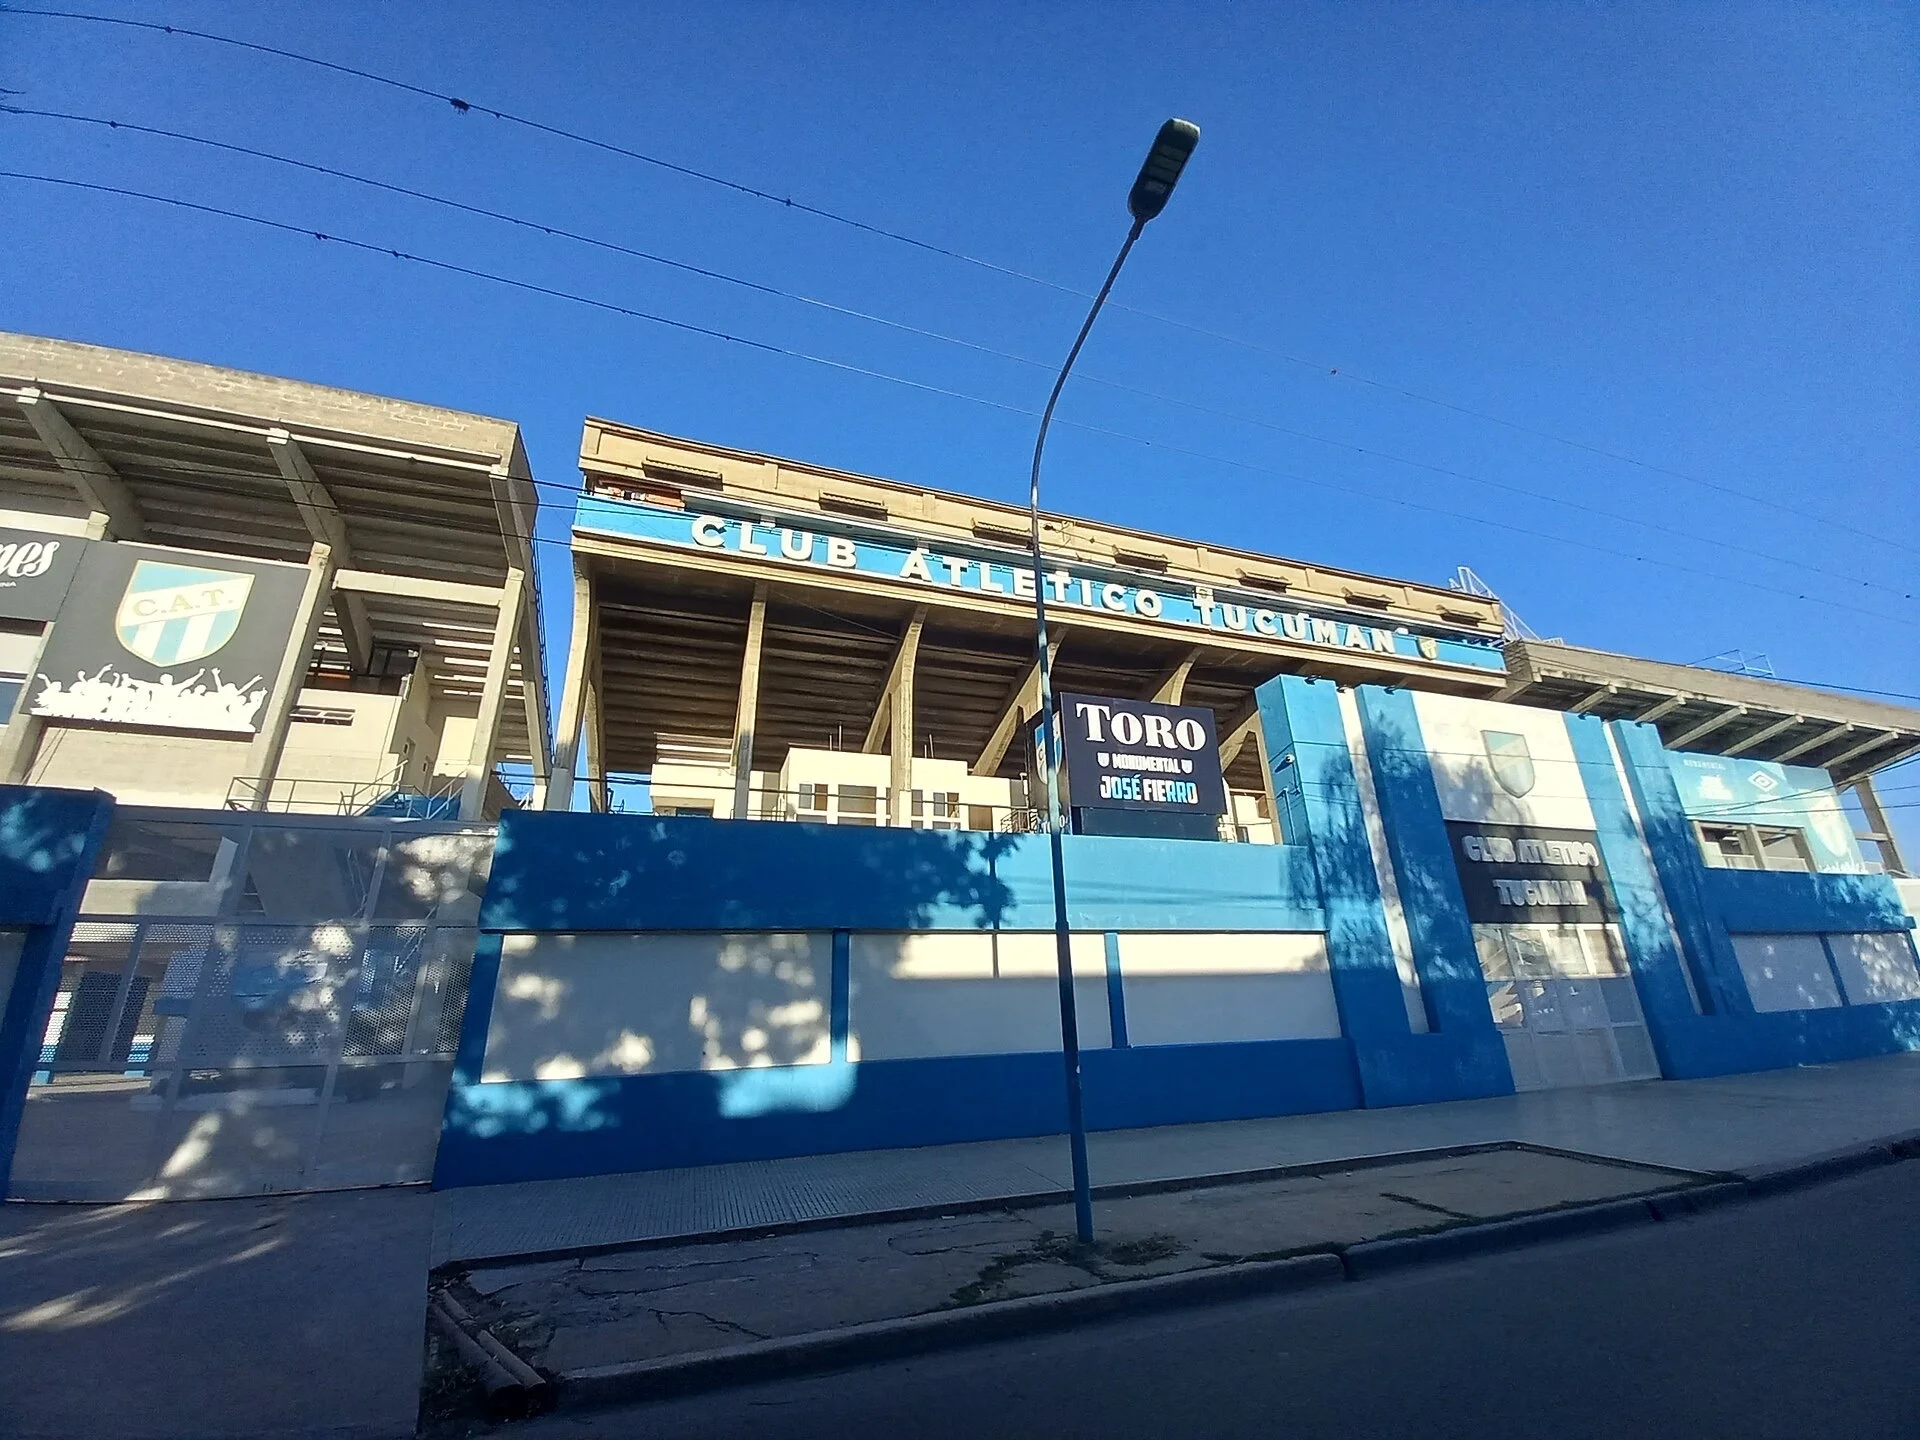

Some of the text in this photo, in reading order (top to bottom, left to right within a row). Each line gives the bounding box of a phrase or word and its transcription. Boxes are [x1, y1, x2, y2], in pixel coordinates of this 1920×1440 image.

[692, 515, 1396, 654] CLUB ATLETICO TUCUMAN
[1075, 703, 1206, 751] TORO
[1112, 753, 1181, 774] MONUMENTAL
[1100, 774, 1199, 804] JOSÉ FIERRO
[1462, 835, 1599, 867] CLUB ATLETICO
[1492, 879, 1588, 907] TUCUMAN
